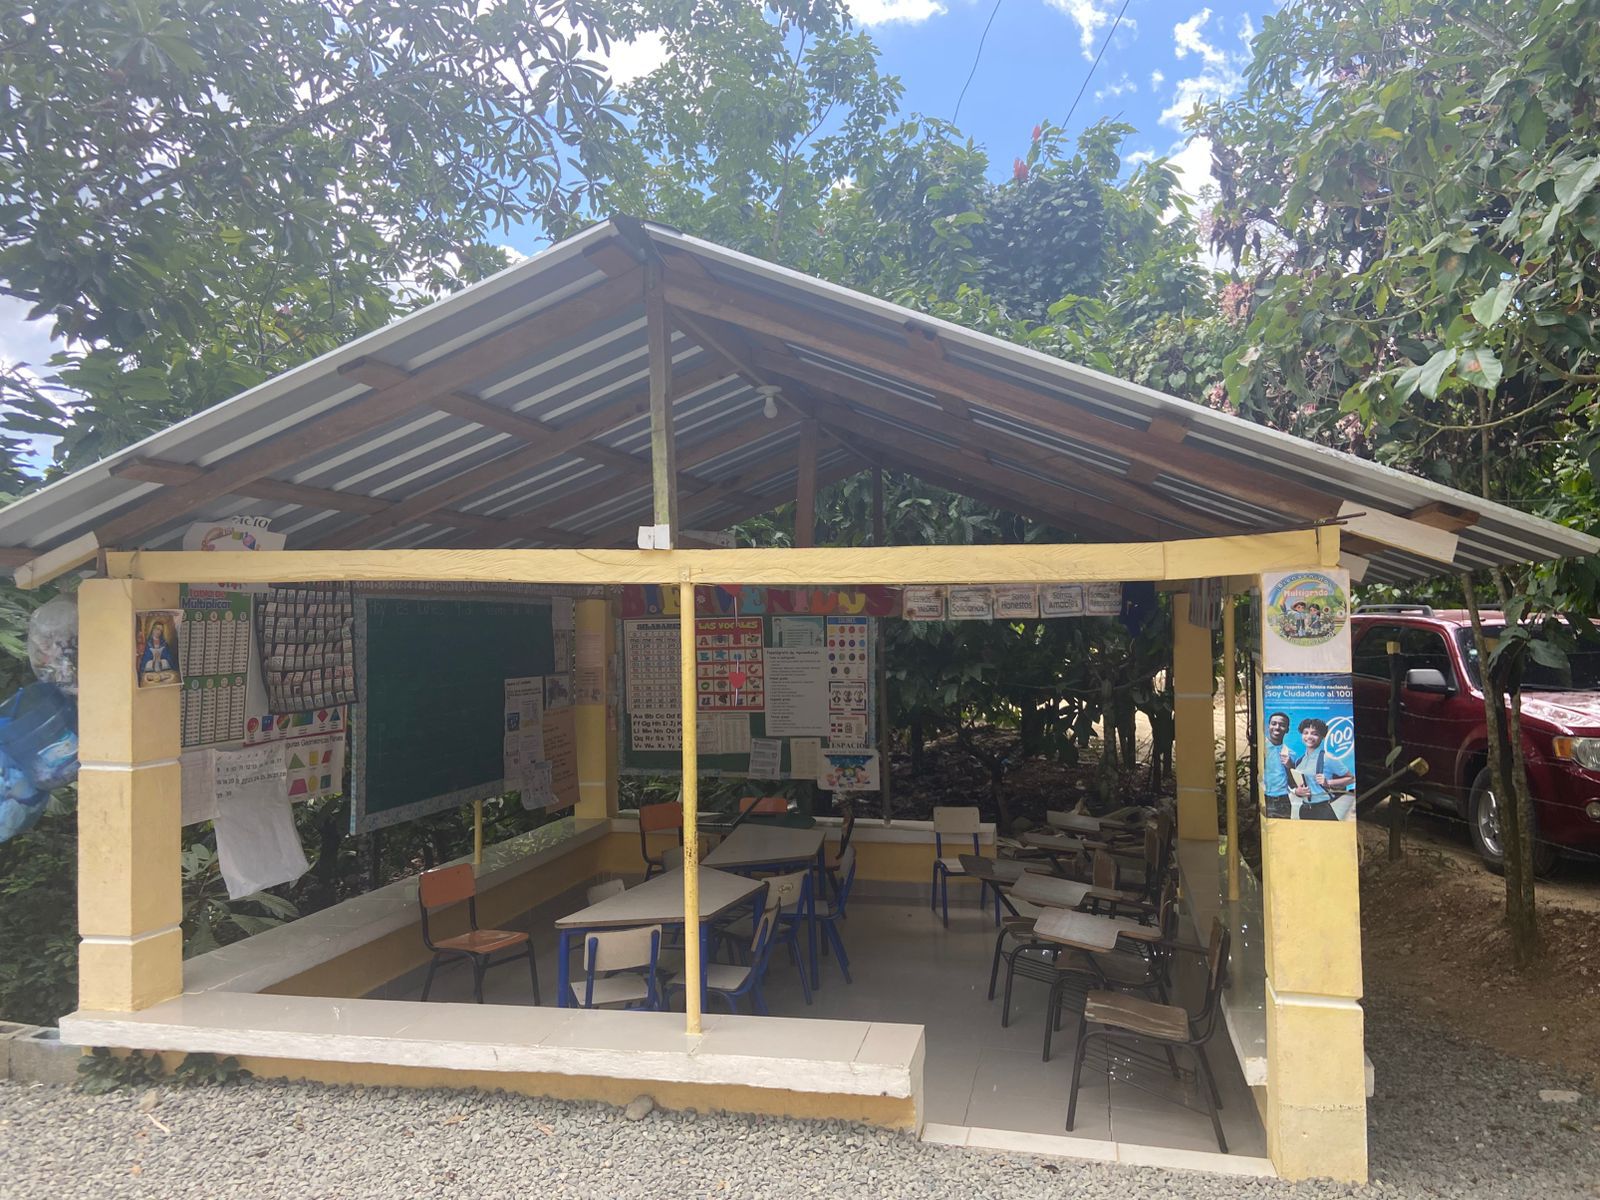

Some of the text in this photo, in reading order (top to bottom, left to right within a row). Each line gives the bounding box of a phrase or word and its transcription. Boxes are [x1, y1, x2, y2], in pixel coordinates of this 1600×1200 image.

[1283, 589, 1329, 598] Multigrado
[181, 597, 232, 610] Multiplicar
[1001, 600, 1033, 610] Honestos
[698, 622, 717, 630] LAS
[1264, 690, 1353, 699] ¡Soy Ciudadano al 100!
[1330, 725, 1352, 747] 100
